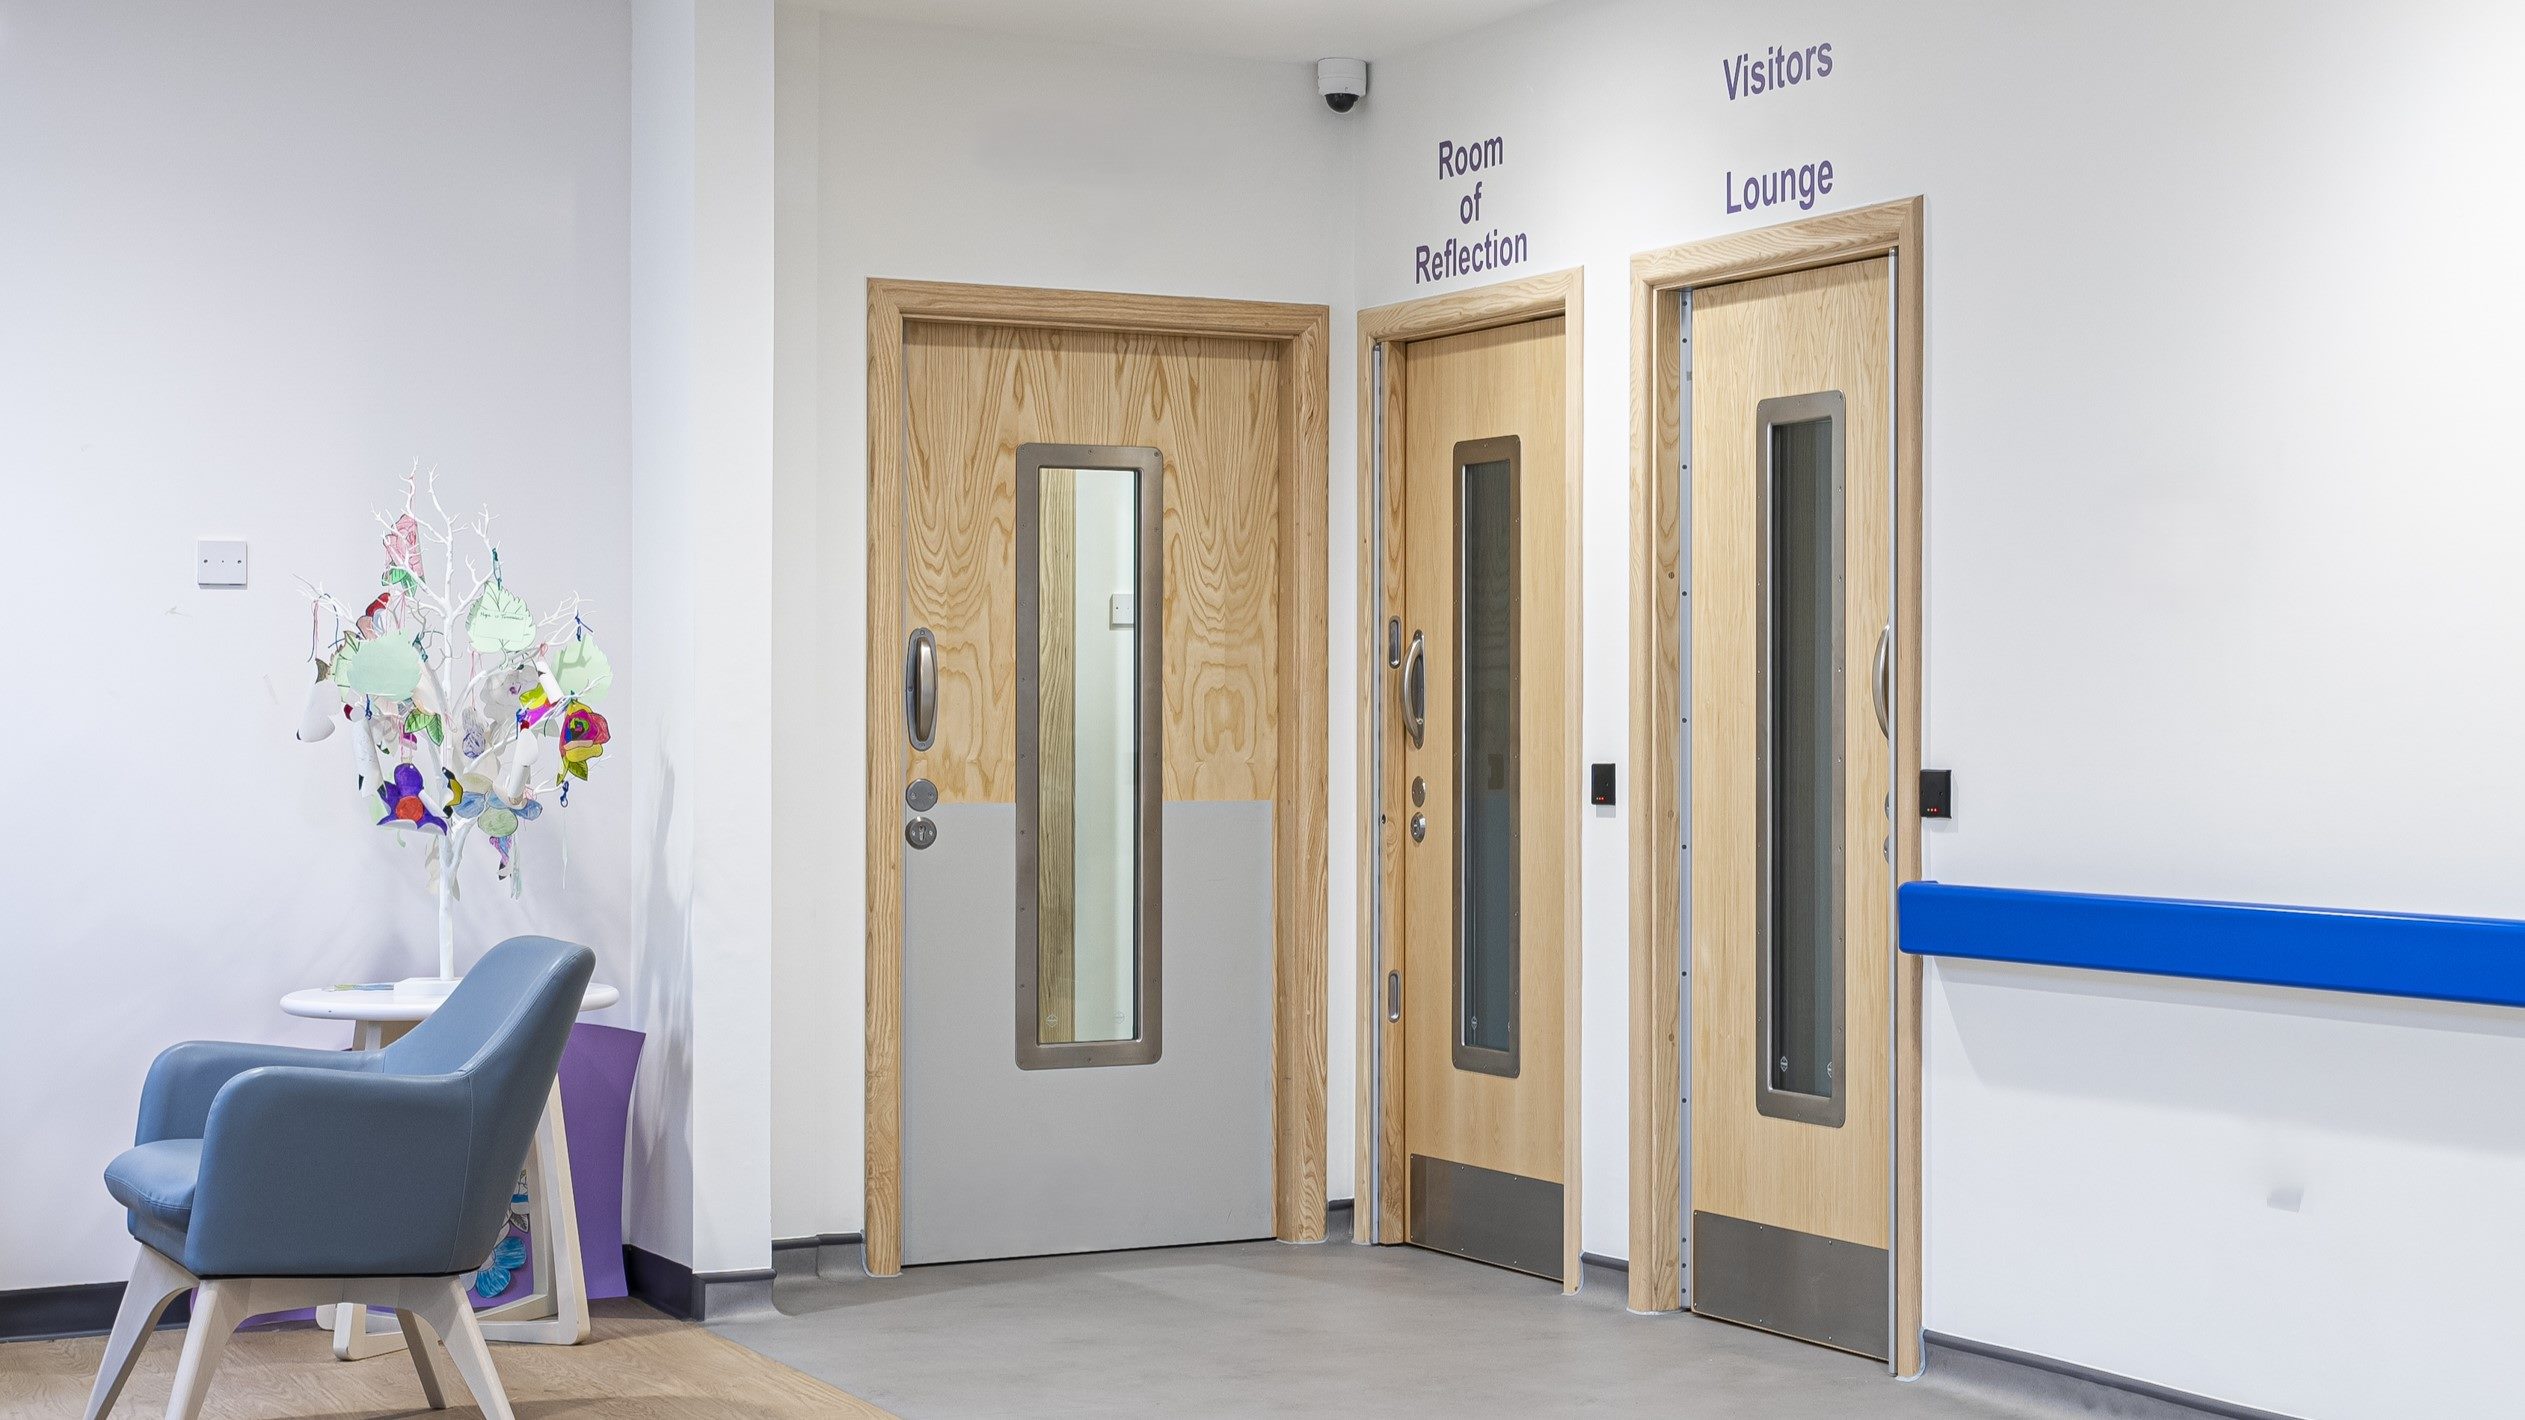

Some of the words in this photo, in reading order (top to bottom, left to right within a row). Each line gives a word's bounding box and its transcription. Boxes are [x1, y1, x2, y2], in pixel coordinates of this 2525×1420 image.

[1722, 42, 1833, 101] Visitors
[1438, 136, 1503, 181] Room
[1459, 181, 1483, 225] of
[1726, 160, 1834, 215] Lounge
[1415, 229, 1527, 285] Reflection
